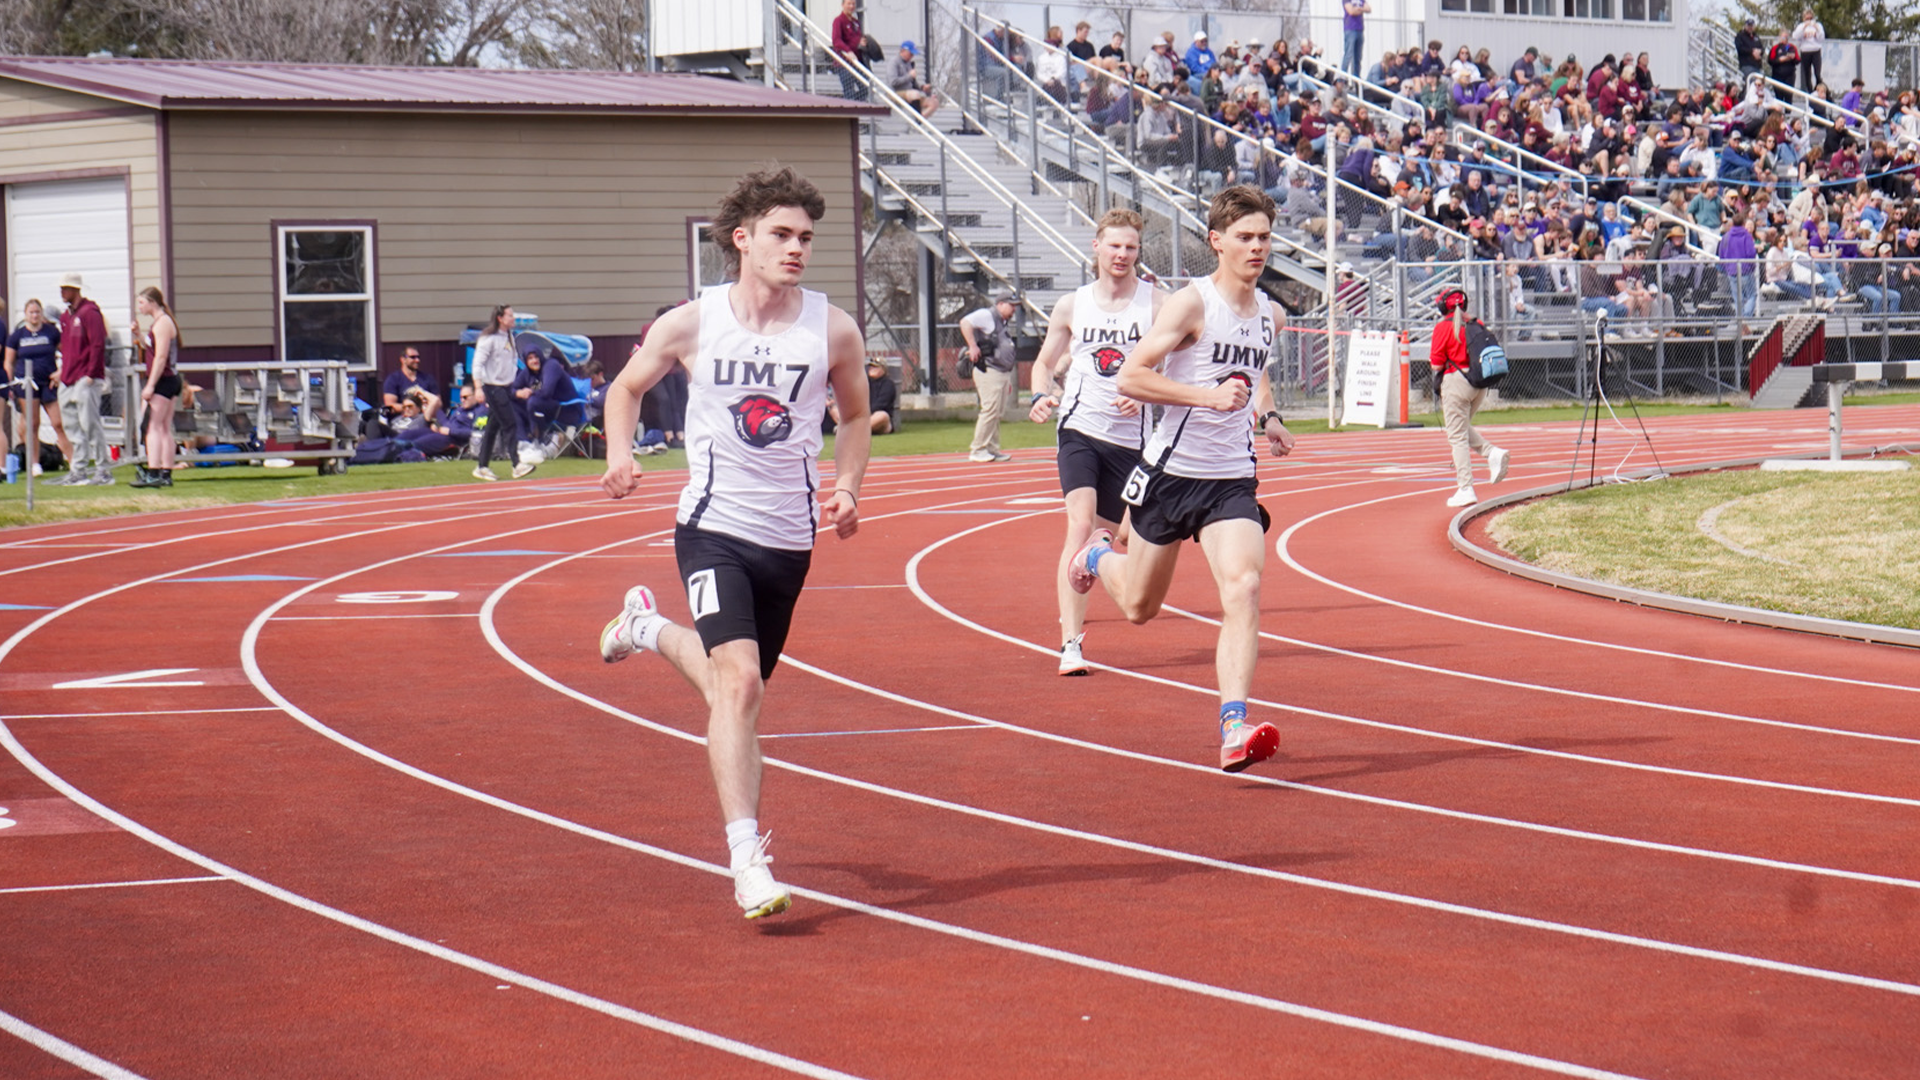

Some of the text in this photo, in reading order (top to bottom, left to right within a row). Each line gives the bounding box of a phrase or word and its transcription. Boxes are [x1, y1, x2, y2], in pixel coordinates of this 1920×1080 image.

[1083, 327, 1126, 345] UM
[1128, 322, 1142, 343] 4
[1261, 316, 1272, 347] 5
[1212, 342, 1269, 370] UMW
[713, 358, 782, 388] UM
[786, 364, 810, 402] 7
[1357, 379, 1377, 387] FINISH
[1126, 470, 1144, 501] 5
[690, 574, 709, 615] 7
